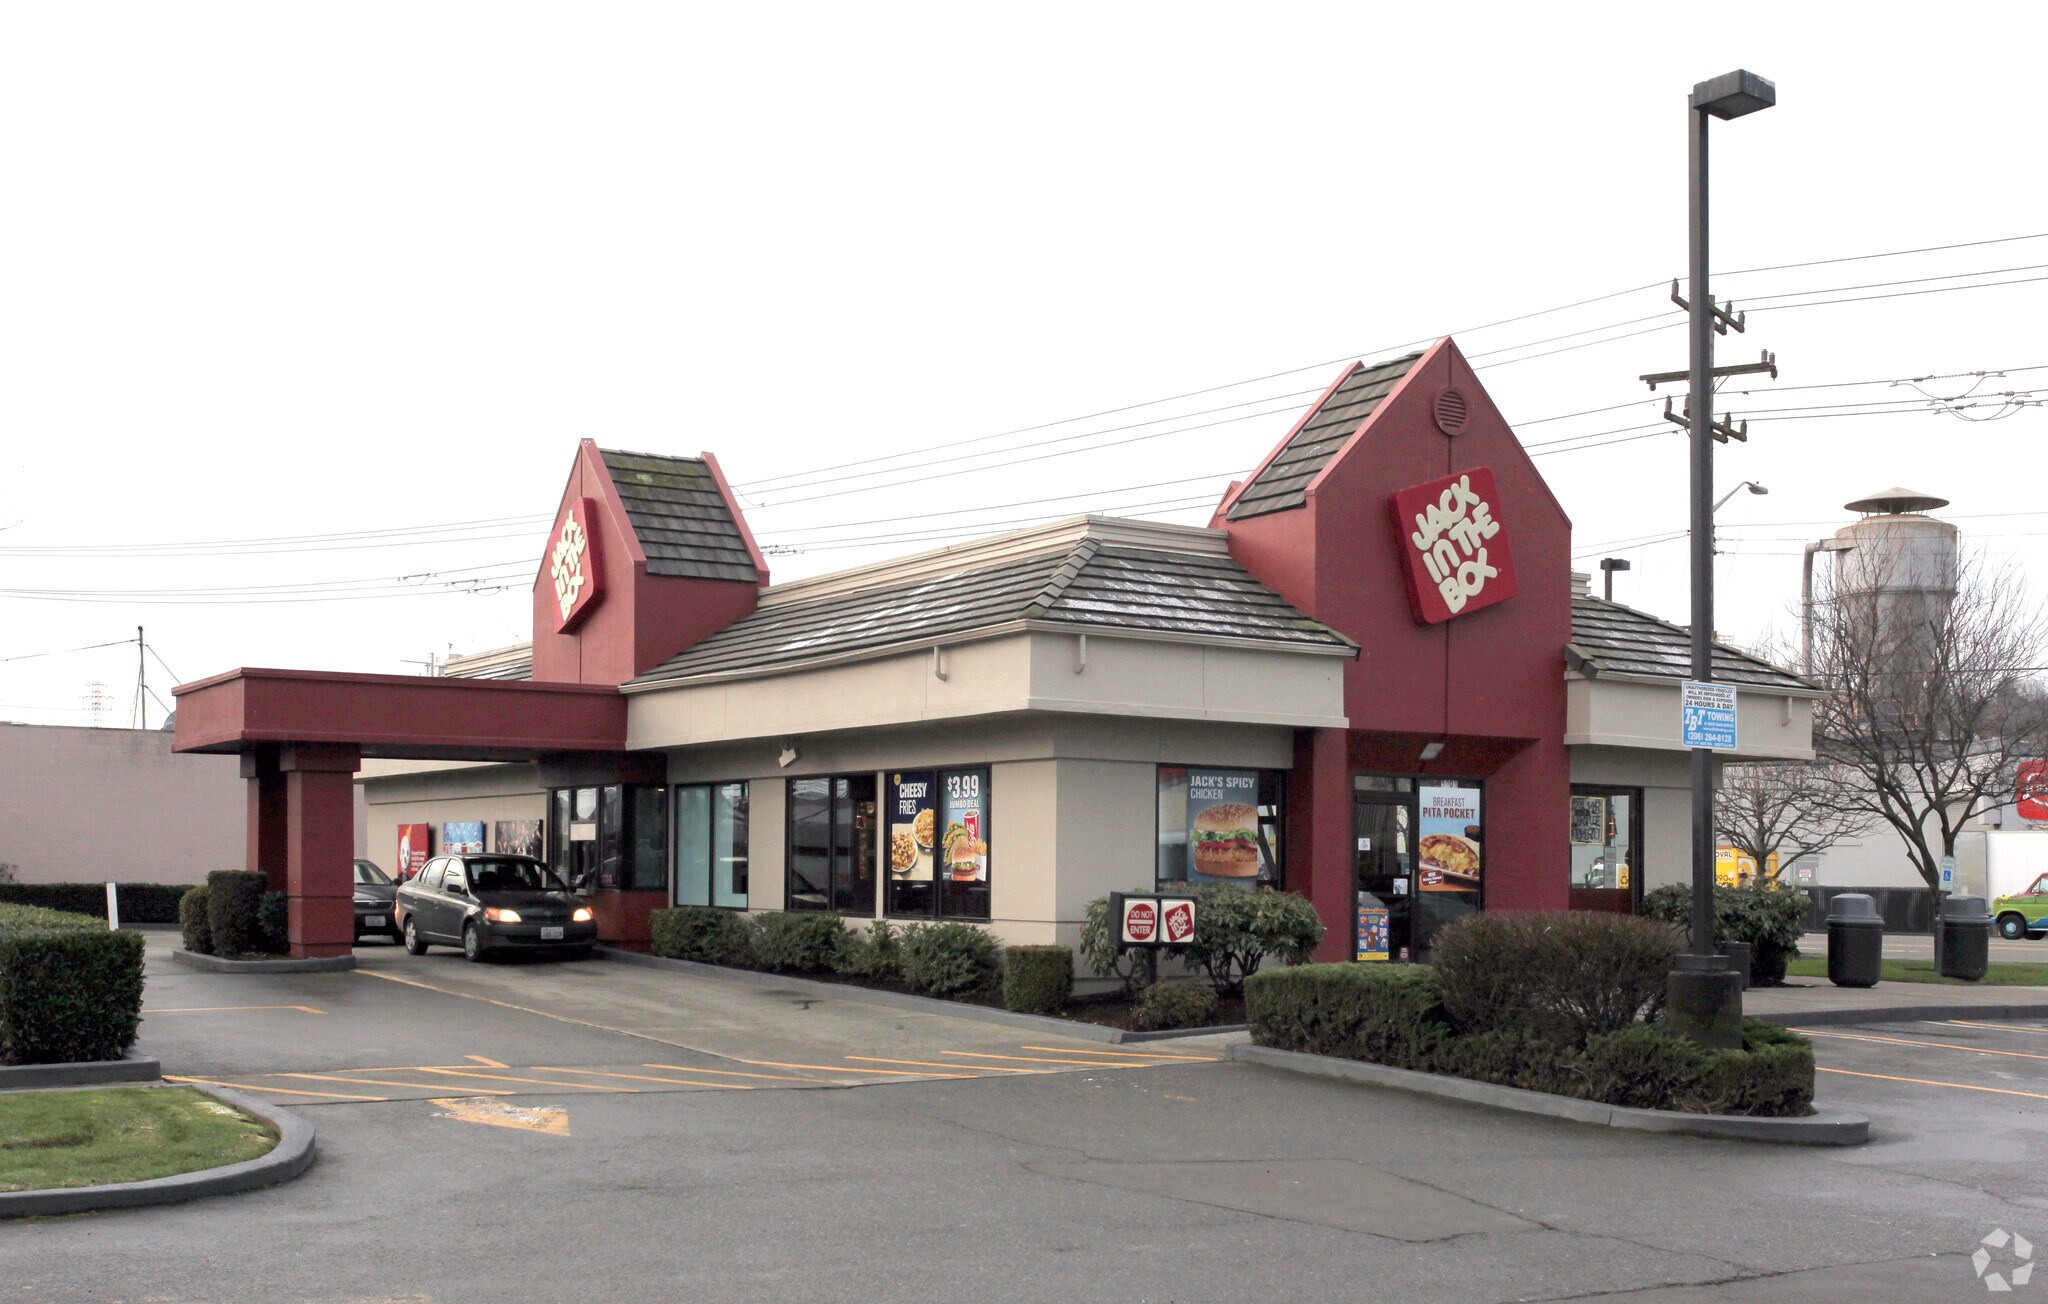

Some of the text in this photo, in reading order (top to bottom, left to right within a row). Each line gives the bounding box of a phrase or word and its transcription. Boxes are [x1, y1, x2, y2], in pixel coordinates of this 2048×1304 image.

[1412, 474, 1480, 550] JACK
[1448, 502, 1500, 556] THE
[551, 510, 578, 579] JACK
[565, 526, 586, 573] THE
[1439, 548, 1498, 614] BOX
[560, 562, 584, 622] BOX
[1685, 708, 1734, 731] TBT TOWING
[1688, 732, 1732, 742] (206) 284-8128
[948, 775, 979, 798] $3.99
[1190, 776, 1254, 788] JACK'S SPICY
[900, 783, 928, 798] CHEESY
[1190, 788, 1223, 799] CHICKEN
[899, 800, 916, 814] FRIES
[950, 800, 966, 808] JUMBO
[1433, 797, 1465, 807] BREAKFAST
[1423, 807, 1475, 818] PITA POCKET
[1130, 926, 1150, 934] ENTER
